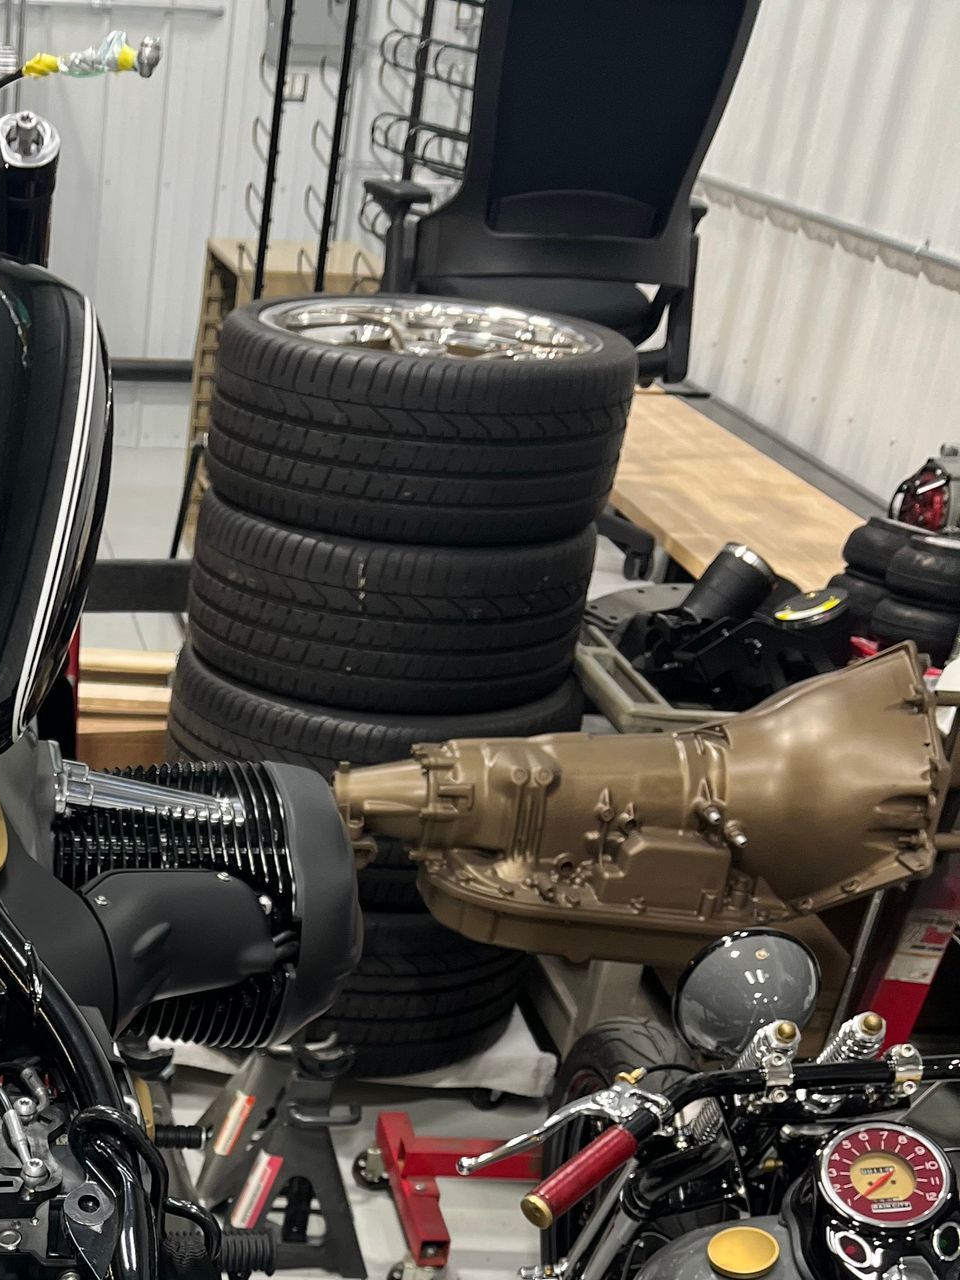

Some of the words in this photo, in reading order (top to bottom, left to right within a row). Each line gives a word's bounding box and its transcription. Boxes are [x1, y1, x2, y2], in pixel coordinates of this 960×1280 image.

[858, 1132, 869, 1141] 6
[879, 1131, 888, 1140] 7
[898, 1135, 908, 1145] 8
[842, 1140, 851, 1149] 5
[915, 1146, 925, 1155] 9
[831, 1153, 840, 1161] 4
[925, 1160, 938, 1170] 10
[828, 1169, 837, 1177] 3
[930, 1176, 940, 1185] 11
[833, 1183, 842, 1193] 2
[925, 1191, 938, 1202] 12
[847, 1198, 852, 1207] 1
